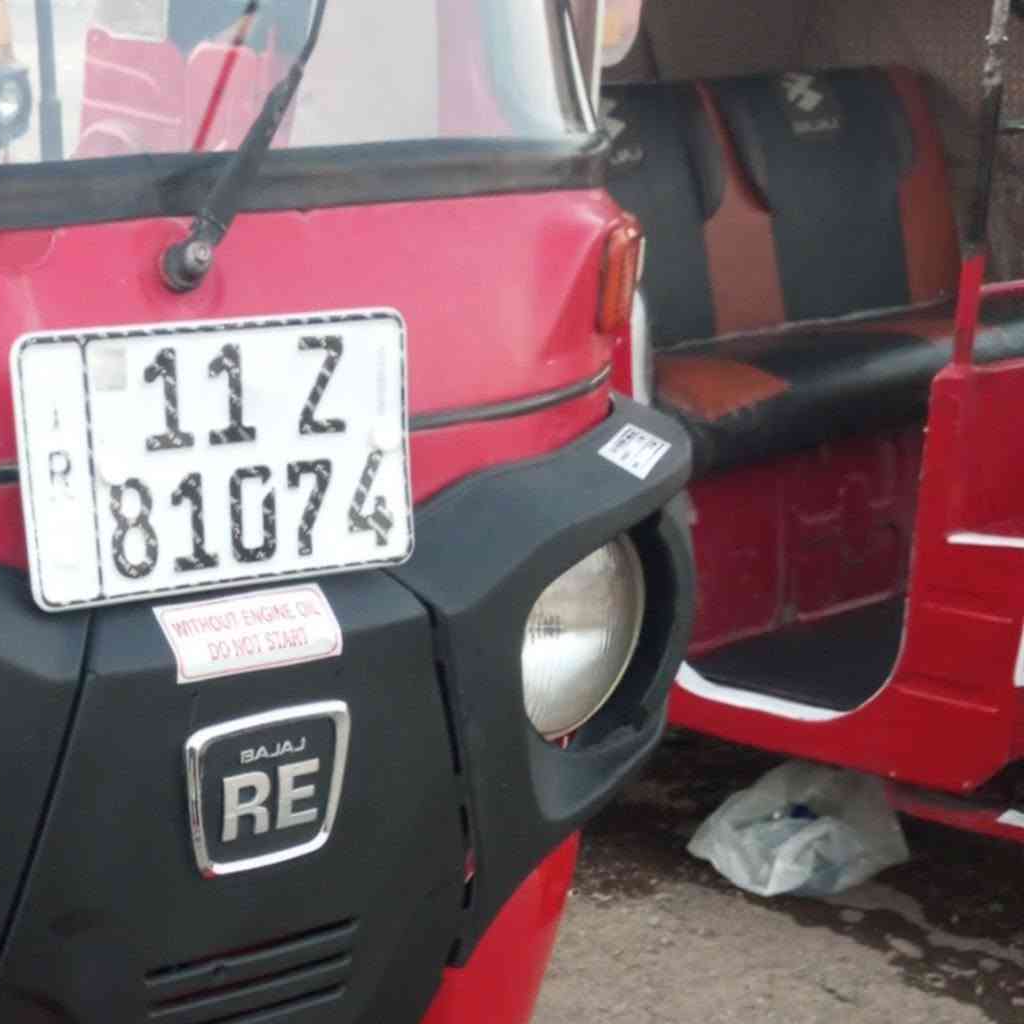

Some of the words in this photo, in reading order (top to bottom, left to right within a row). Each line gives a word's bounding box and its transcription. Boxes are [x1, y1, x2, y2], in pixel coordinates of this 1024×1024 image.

[143, 343, 257, 451] 11
[298, 335, 346, 435] Z
[109, 449, 394, 578] 81074
[172, 611, 238, 638] WITHOUT
[241, 602, 297, 627] ENGINE
[208, 640, 232, 661] DO
[232, 632, 264, 657] NOT
[264, 626, 310, 651] START
[240, 737, 307, 764] BAJAJ
[221, 757, 320, 842] RE
